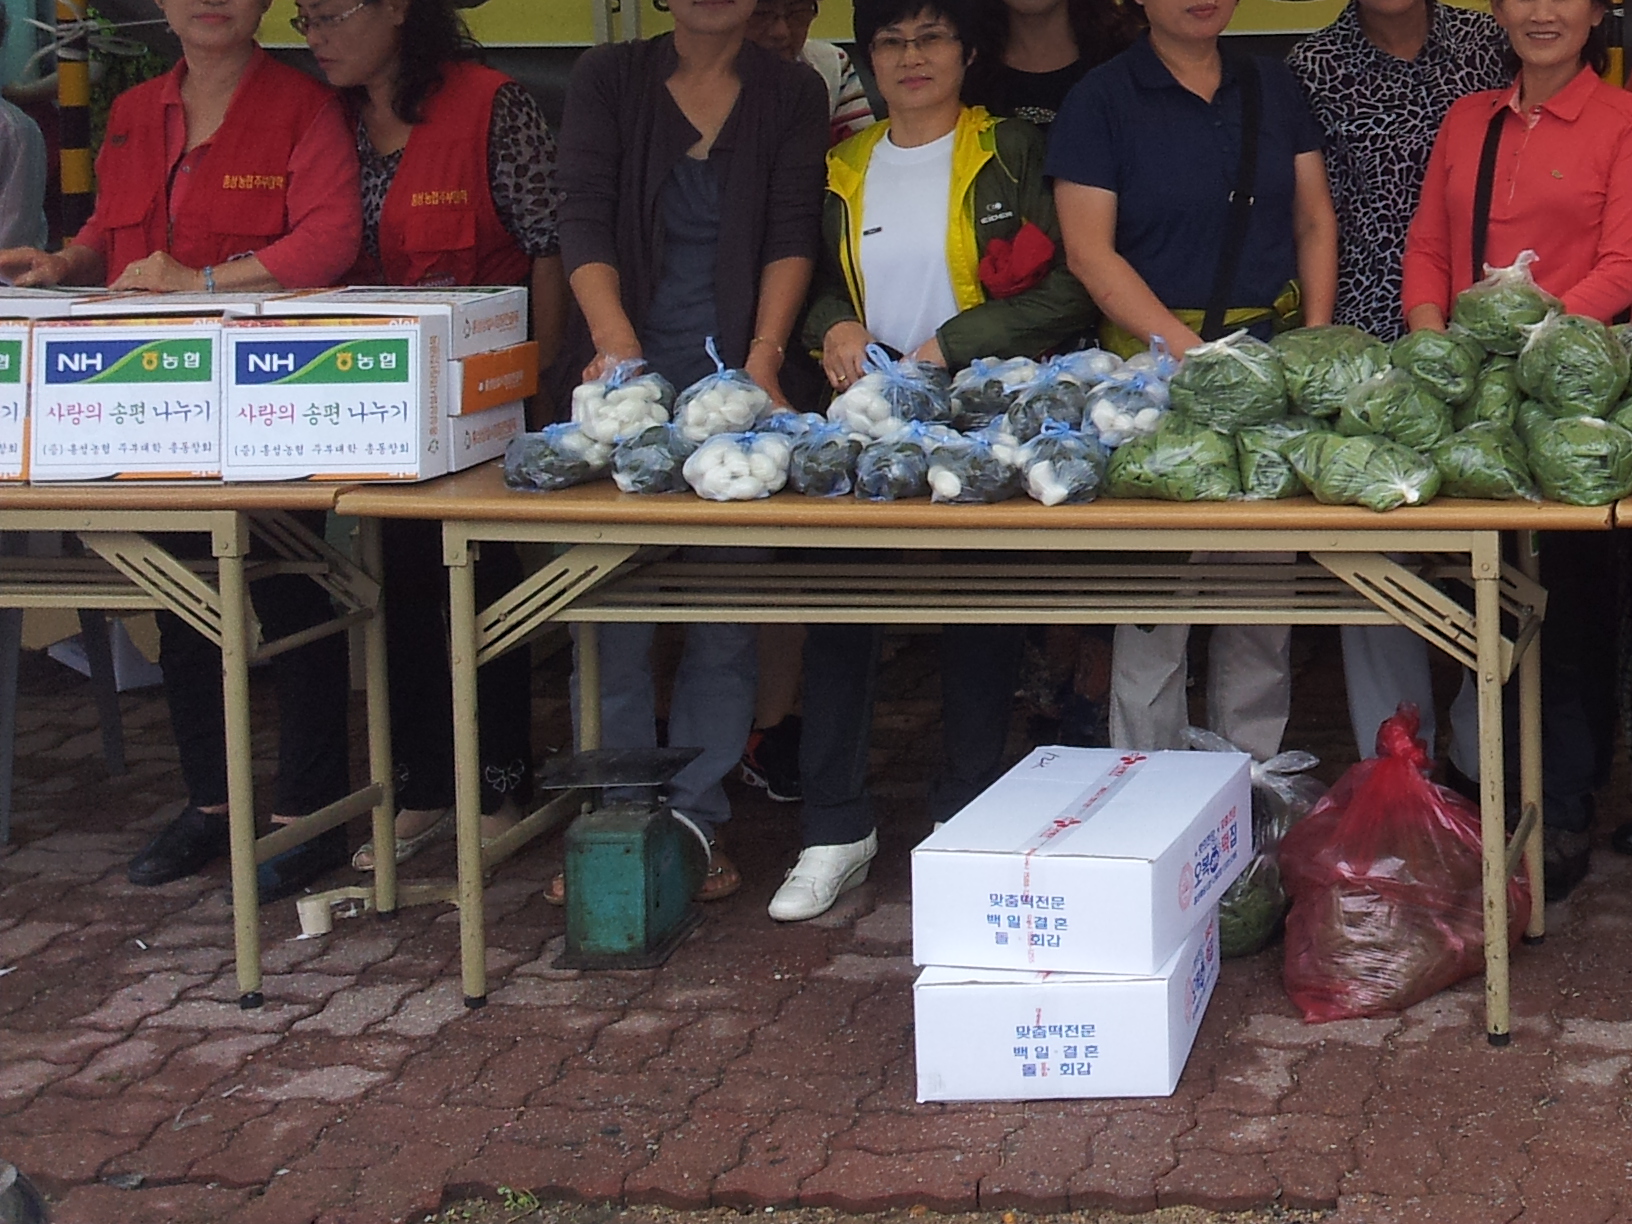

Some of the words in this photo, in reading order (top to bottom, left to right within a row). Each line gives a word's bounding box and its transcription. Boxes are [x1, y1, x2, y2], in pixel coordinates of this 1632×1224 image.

[57, 353, 103, 372] NH
[163, 351, 199, 369] 농협
[248, 353, 294, 372] NH
[357, 352, 396, 369] 농협
[49, 402, 102, 426] 사랑의
[109, 401, 145, 425] 송편
[153, 400, 211, 423] 나누기
[238, 403, 295, 426] 사랑의
[302, 402, 340, 426] 송편
[348, 400, 407, 423] 나누기
[989, 893, 1065, 910] 맞춤떡전문
[1030, 933, 1061, 948] 회갑
[1016, 1024, 1096, 1039] 맞춤떡전문
[1059, 1062, 1092, 1076] 회갑
